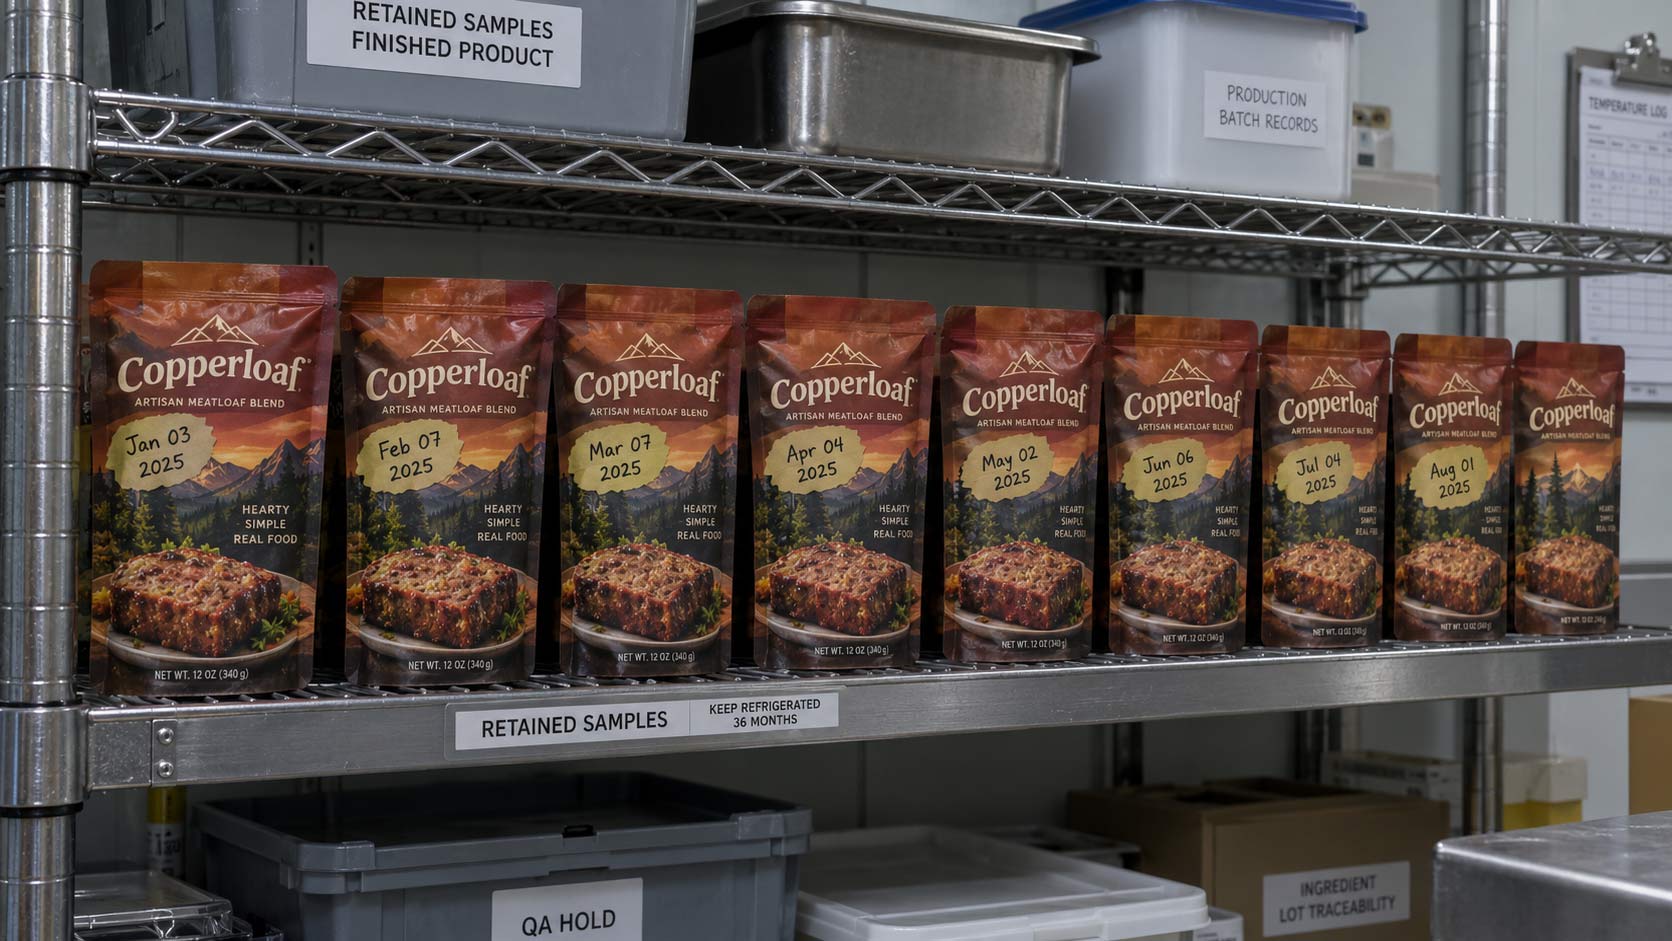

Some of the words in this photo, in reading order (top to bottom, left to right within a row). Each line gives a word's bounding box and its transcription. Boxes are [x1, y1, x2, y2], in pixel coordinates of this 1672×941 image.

[354, 1, 456, 29] RETAINED
[464, 13, 554, 40] SAMPLES
[352, 30, 452, 58] FINISHED
[460, 41, 554, 68] PRODUCT
[1228, 84, 1307, 107] PRODUCTION
[1588, 96, 1648, 116] TEMPERATURE
[1650, 104, 1668, 118] LOG
[1220, 109, 1260, 128] BATCH
[1266, 114, 1318, 133] RECORDS
[118, 349, 307, 393] Copperloaf
[366, 358, 532, 400] Copperloaf
[574, 364, 722, 404] Copperloaf
[770, 370, 916, 410] Copperloaf
[134, 397, 184, 408] ARTISAN
[188, 397, 246, 408] MEATLOAF
[250, 397, 286, 408] BLEND
[962, 378, 1088, 417] Copperloaf
[1123, 384, 1242, 420] Copperloaf
[1278, 390, 1380, 425] Copperloaf
[382, 404, 426, 414] ARTISAN
[430, 404, 483, 414] MEATLOAF
[486, 404, 517, 414] BLEND
[590, 407, 630, 417] ARTISAN
[633, 407, 678, 417] MEATLOAF
[680, 407, 709, 417] BLEND
[786, 412, 824, 422] ARTISAN
[828, 412, 874, 422] MEATLOAF
[876, 412, 904, 422] BLEND
[1409, 396, 1502, 429] Copperloaf
[1529, 399, 1616, 432] Copperloaf
[976, 418, 1012, 427] ARTISAN
[1015, 418, 1055, 427] MEATLOAF
[1138, 422, 1171, 431] ARTISAN
[1174, 422, 1210, 431] MEATLOAF
[1212, 422, 1234, 431] BLEND
[125, 434, 160, 456] Jan
[168, 426, 192, 446] 03
[378, 437, 410, 460] Feb
[418, 430, 441, 450] 07
[590, 440, 624, 461] Mar
[630, 434, 651, 452] 07
[787, 444, 816, 465] Apr
[823, 436, 844, 454] 04
[139, 453, 184, 478] 2025
[389, 457, 433, 482] 2025
[982, 454, 1012, 472] May
[1018, 446, 1038, 462] 02
[1143, 456, 1171, 474] Jun
[1176, 450, 1194, 466] 06
[1296, 456, 1318, 476] Jul
[1325, 452, 1341, 468] 04
[1430, 462, 1456, 482] Aug
[1462, 457, 1474, 472] 01
[600, 460, 641, 482] 2025
[797, 461, 838, 483] 2025
[994, 469, 1031, 491] 2025
[1153, 472, 1188, 493] 2025
[1305, 474, 1336, 494] 2025
[1440, 480, 1470, 499] 2025
[242, 504, 290, 515] HEARTY
[484, 504, 522, 514] HEARTY
[683, 504, 718, 514] HEARTY
[879, 504, 910, 513] HEARTY
[245, 519, 286, 529] SIMPLE
[487, 517, 520, 528] SIMPLE
[686, 517, 716, 526] SIMPLE
[881, 516, 910, 526] SIMPLE
[233, 534, 264, 544] REAL
[267, 534, 298, 544] FOOD
[477, 532, 503, 542] REAL
[506, 532, 528, 542] FOOD
[677, 530, 700, 540] REAL
[702, 530, 722, 540] FOOD
[874, 530, 896, 538] REAL
[814, 646, 830, 655] NET
[830, 646, 844, 655] WT.
[846, 646, 854, 655] 12
[855, 646, 866, 654] OZ
[1030, 640, 1038, 648] 12
[408, 660, 424, 670] NET
[426, 660, 441, 670] WT.
[444, 660, 452, 670] 12
[454, 660, 466, 670] OZ
[468, 659, 484, 670] (340
[618, 652, 633, 662] NET
[634, 652, 648, 662] WT.
[650, 652, 658, 662] 12
[660, 652, 670, 661] OZ
[154, 670, 172, 680] NET
[174, 670, 190, 680] WT.
[192, 670, 202, 680] 12
[204, 669, 217, 680] OZ
[218, 668, 239, 680] (340
[240, 668, 249, 680] g)
[710, 703, 738, 714] KEEP
[742, 698, 820, 713] REFRIGERATED
[482, 716, 576, 738] RETAINED
[584, 711, 668, 732] SAMPLES
[733, 716, 747, 728] 36
[750, 714, 798, 727] MONTHS
[1300, 874, 1377, 896] INGREDIENT
[1280, 905, 1306, 923] LOT
[1308, 895, 1396, 919] TRACEABILITY
[522, 915, 552, 936] QA
[560, 910, 616, 932] HOLD
